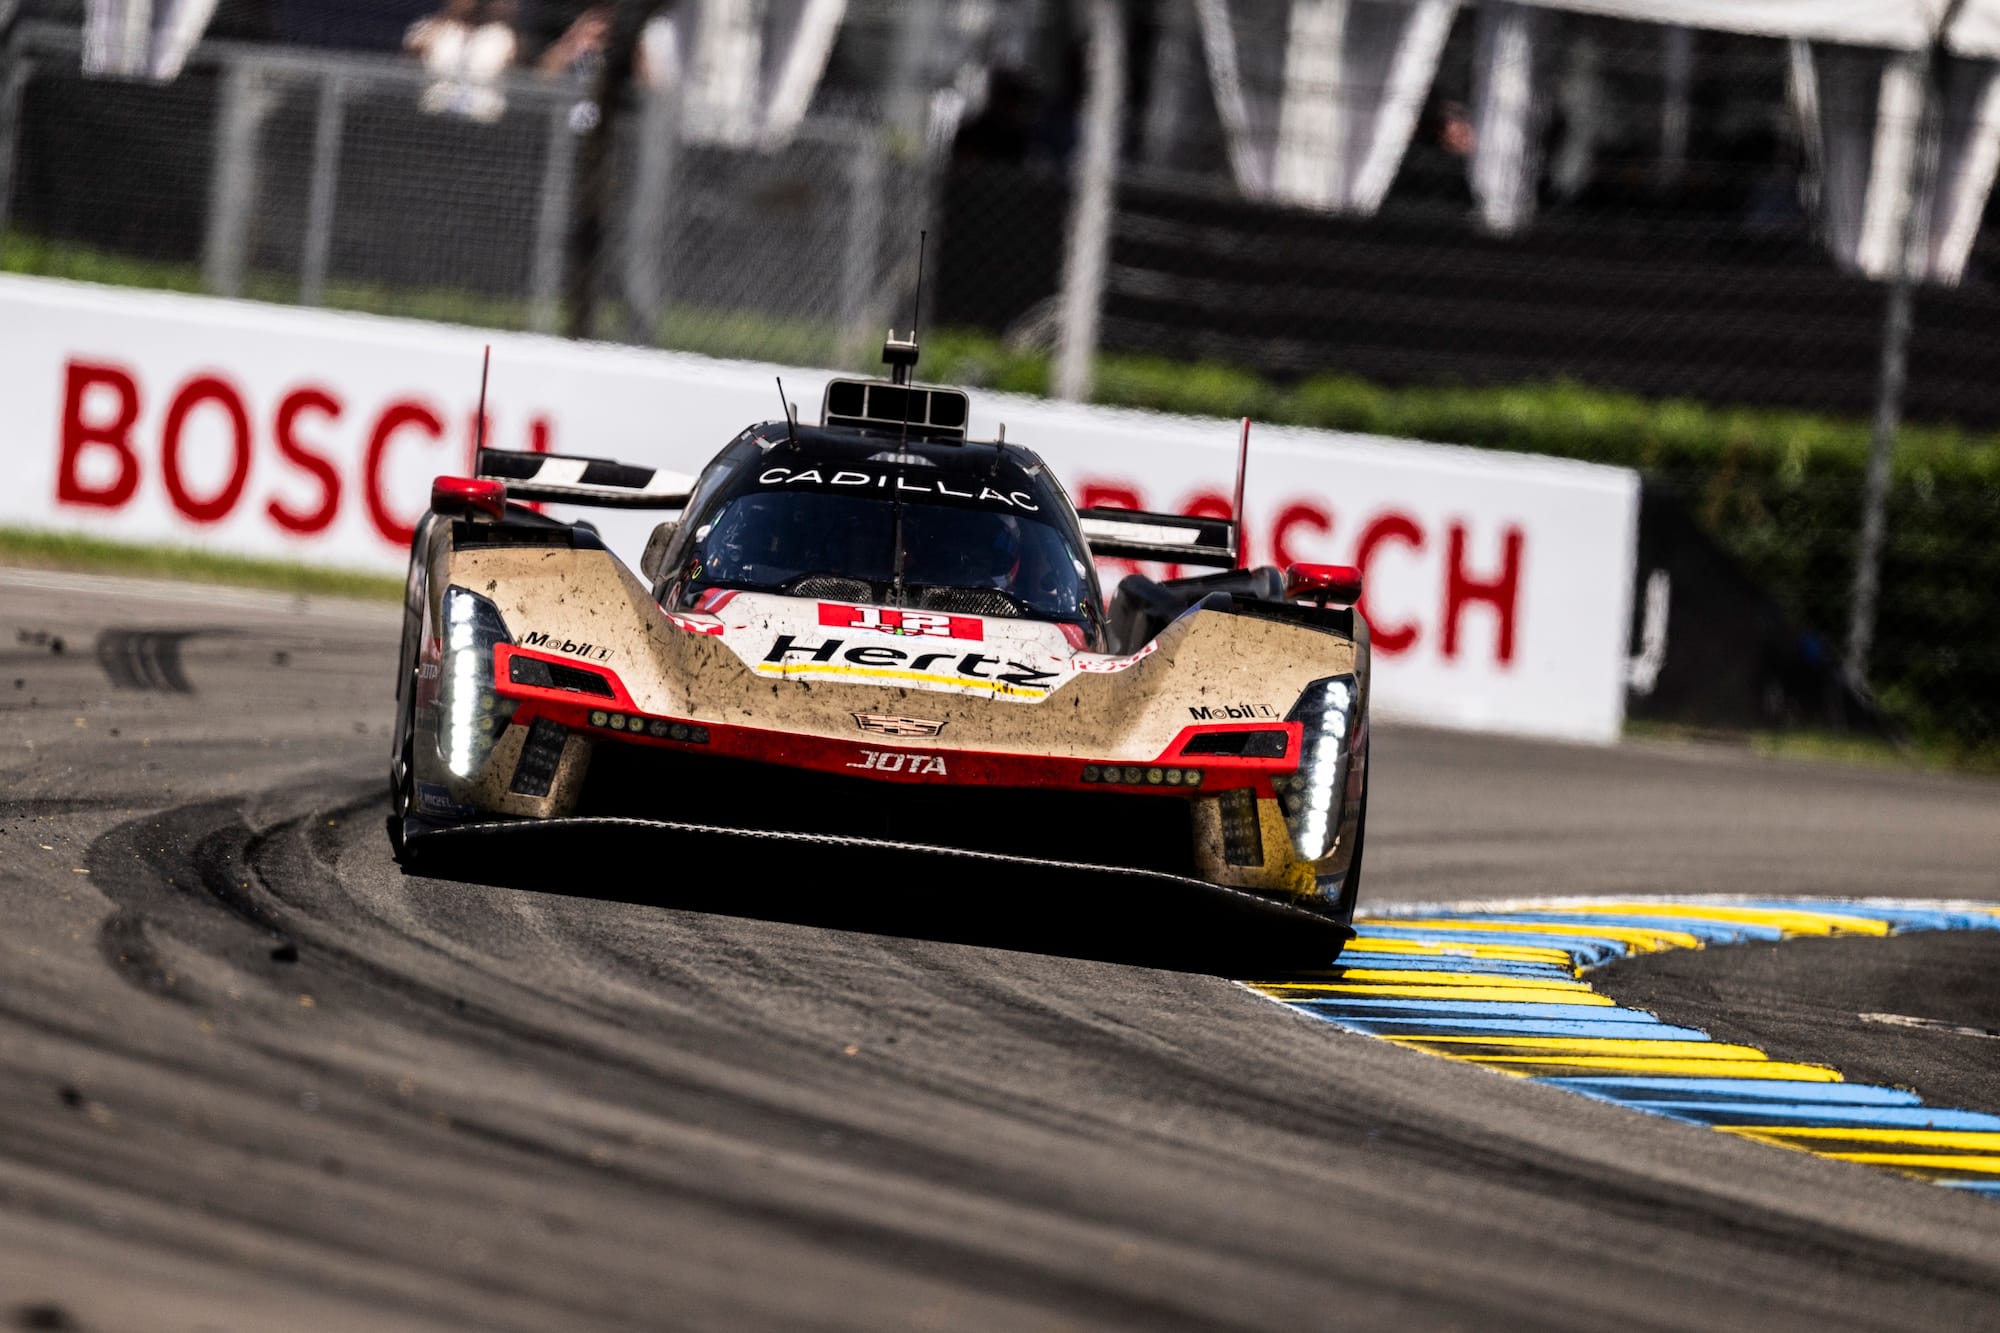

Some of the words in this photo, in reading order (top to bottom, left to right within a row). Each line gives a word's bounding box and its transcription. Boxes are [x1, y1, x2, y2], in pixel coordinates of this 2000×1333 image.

[57, 358, 549, 551] BOSC
[758, 467, 1040, 512] CADILLAC
[850, 607, 951, 637] 12
[525, 631, 593, 657] Mobil
[763, 634, 1060, 688] Hertz
[1188, 704, 1256, 721] Mobil
[845, 749, 948, 776] JOTA
